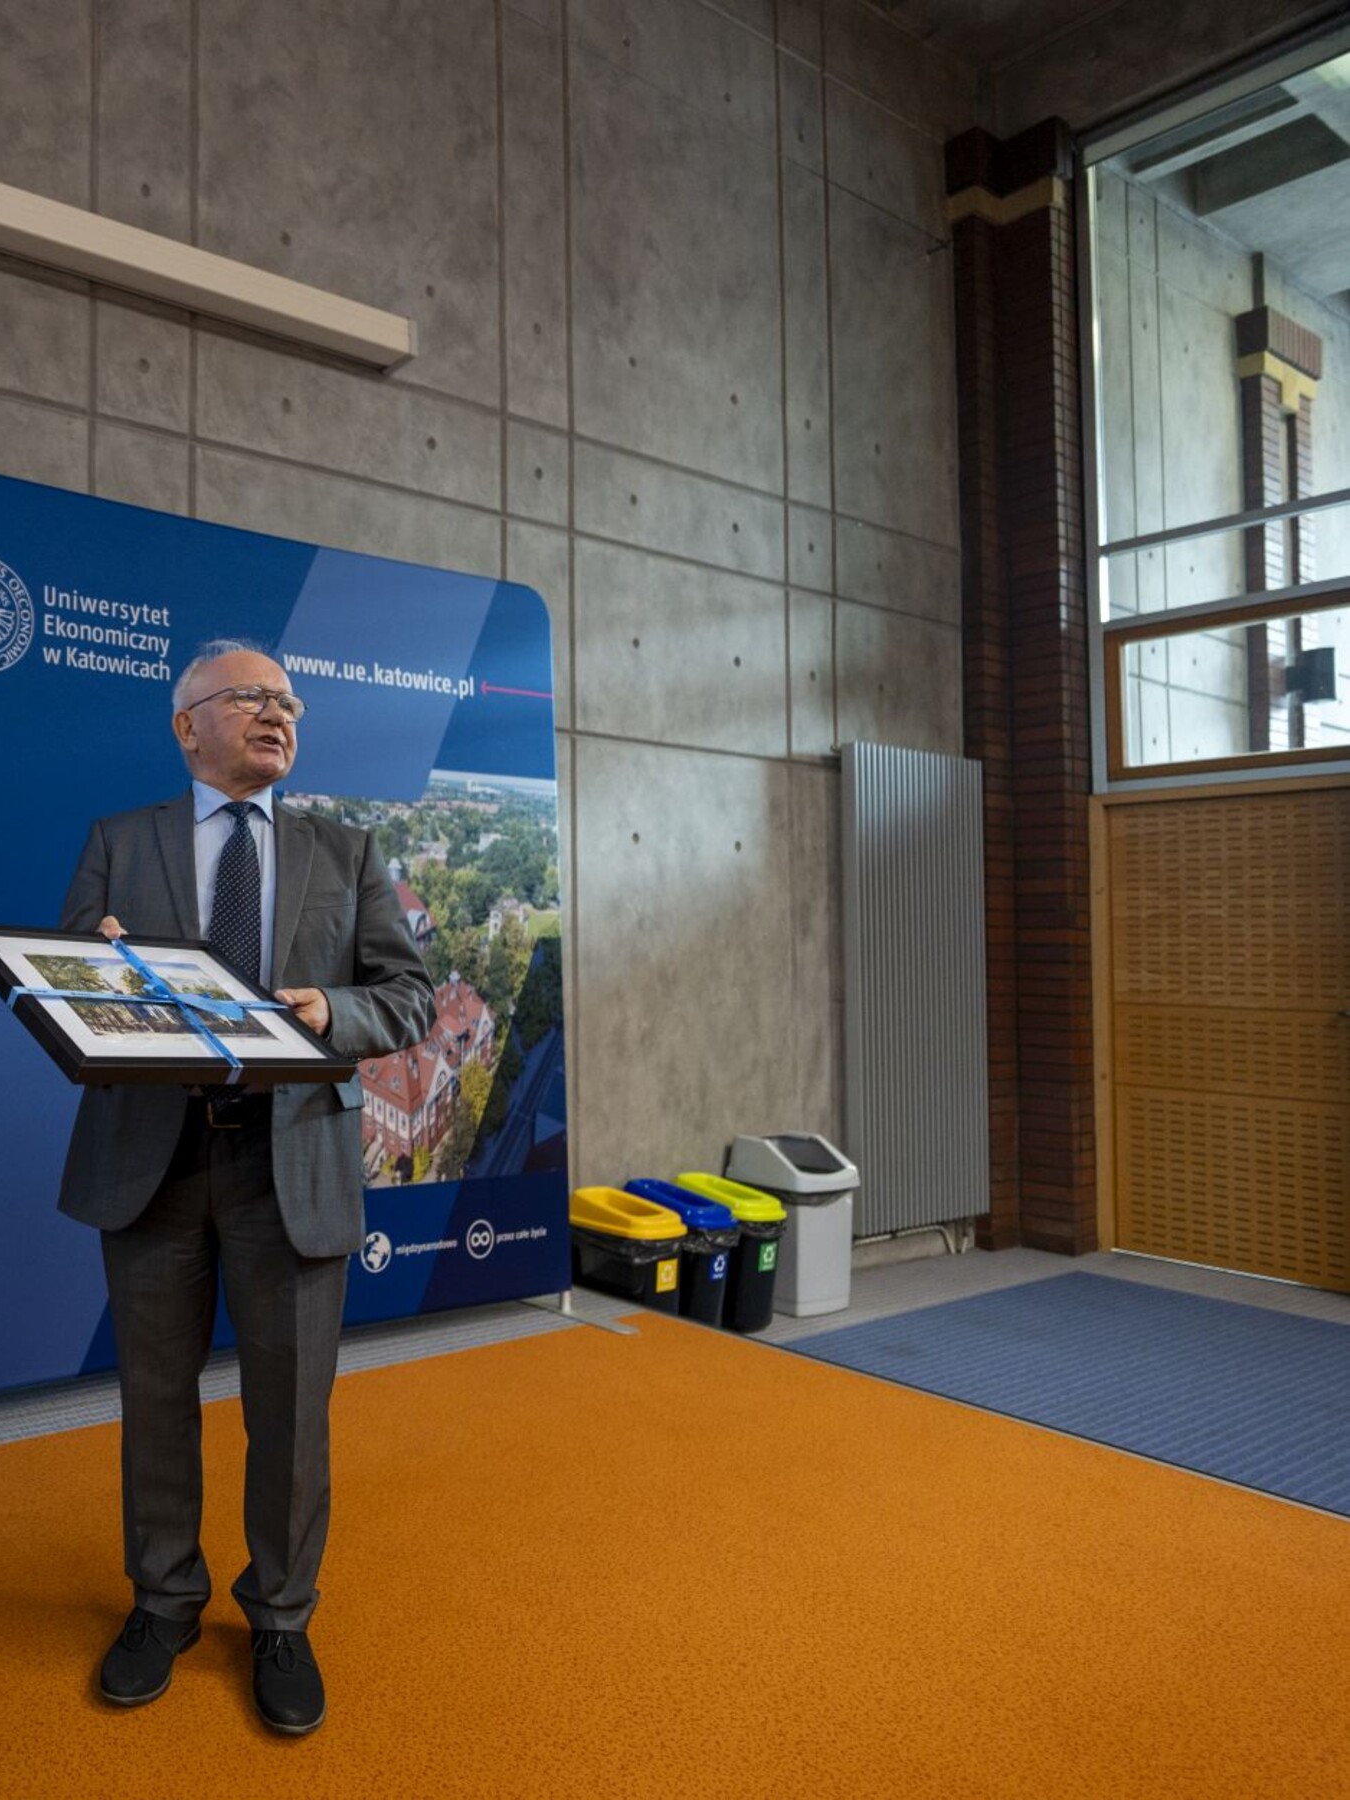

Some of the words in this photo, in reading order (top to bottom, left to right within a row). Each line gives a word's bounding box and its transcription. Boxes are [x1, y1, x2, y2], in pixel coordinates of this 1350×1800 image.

[43, 585, 170, 628] Uniwersytet
[43, 614, 170, 658] Ekonomiczny
[43, 647, 62, 665] w
[66, 646, 171, 681] Katowicach
[283, 653, 475, 700] www.ue.katowice.pl
